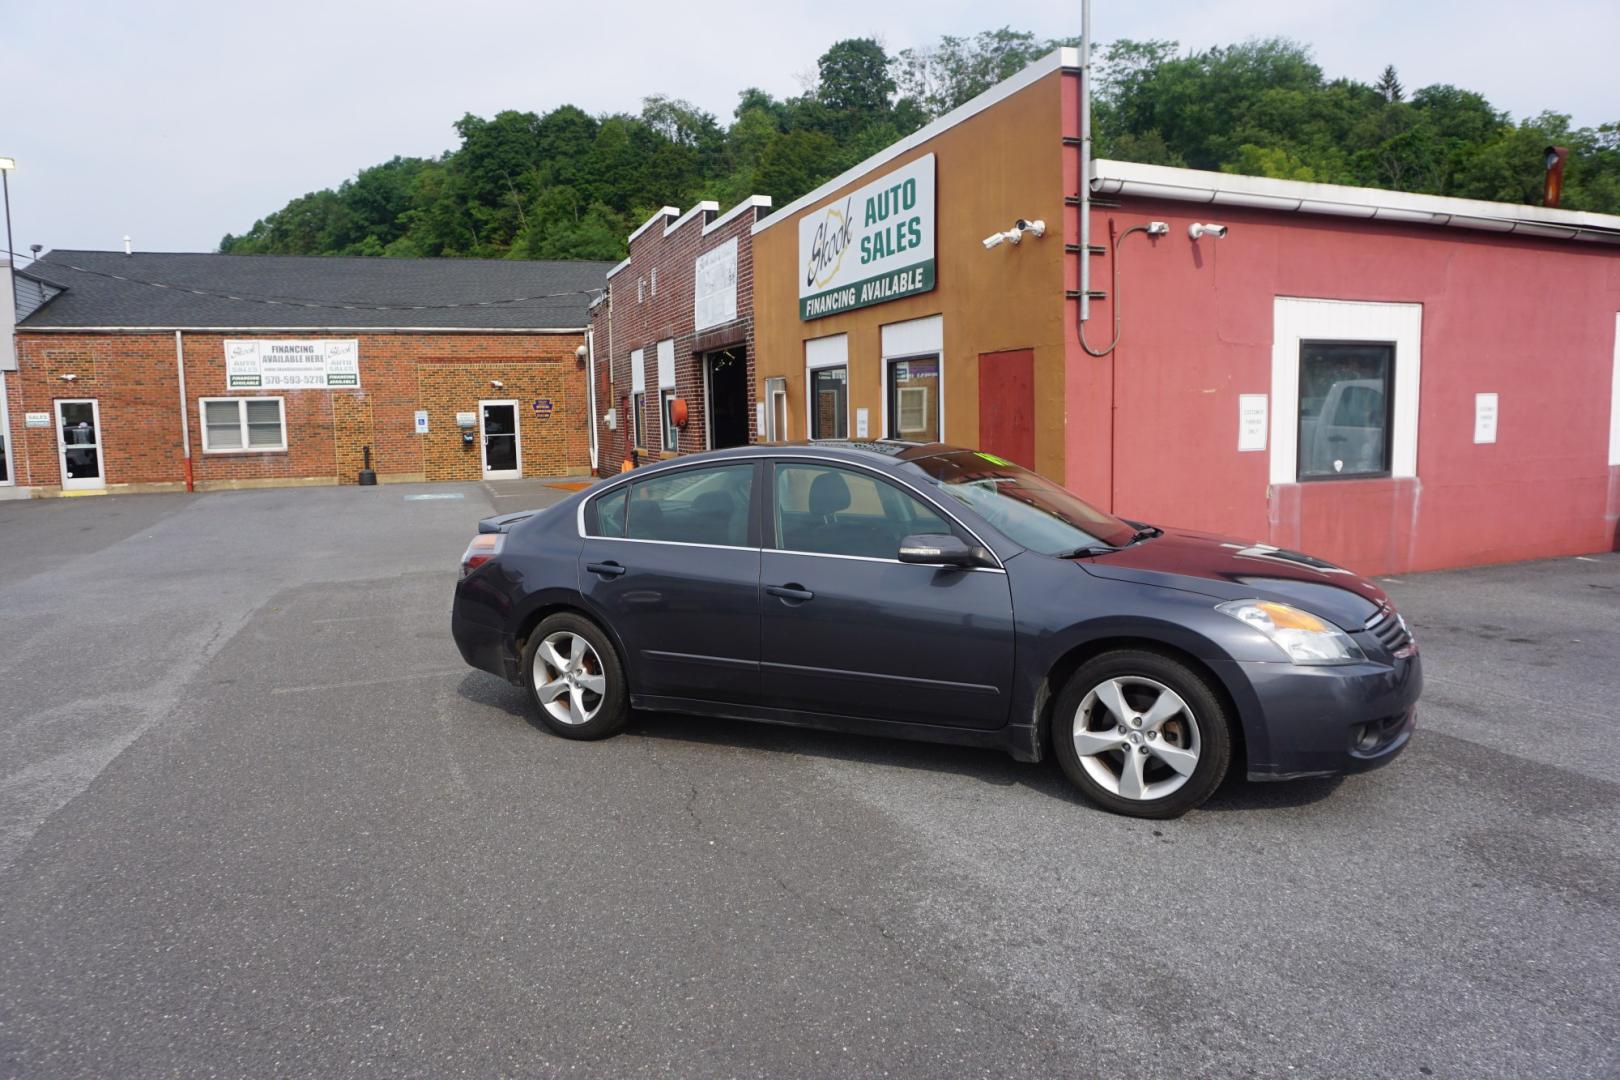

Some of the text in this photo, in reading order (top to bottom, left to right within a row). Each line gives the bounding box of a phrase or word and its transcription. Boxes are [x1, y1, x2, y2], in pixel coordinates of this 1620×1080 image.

[864, 177, 916, 228] AUTO
[807, 197, 853, 288] Skook
[860, 215, 922, 265] SALES
[806, 267, 924, 317] FINANCING AVAILABLE
[262, 354, 324, 363] AVAILABLE HERE
[271, 345, 314, 353] FINANCING
